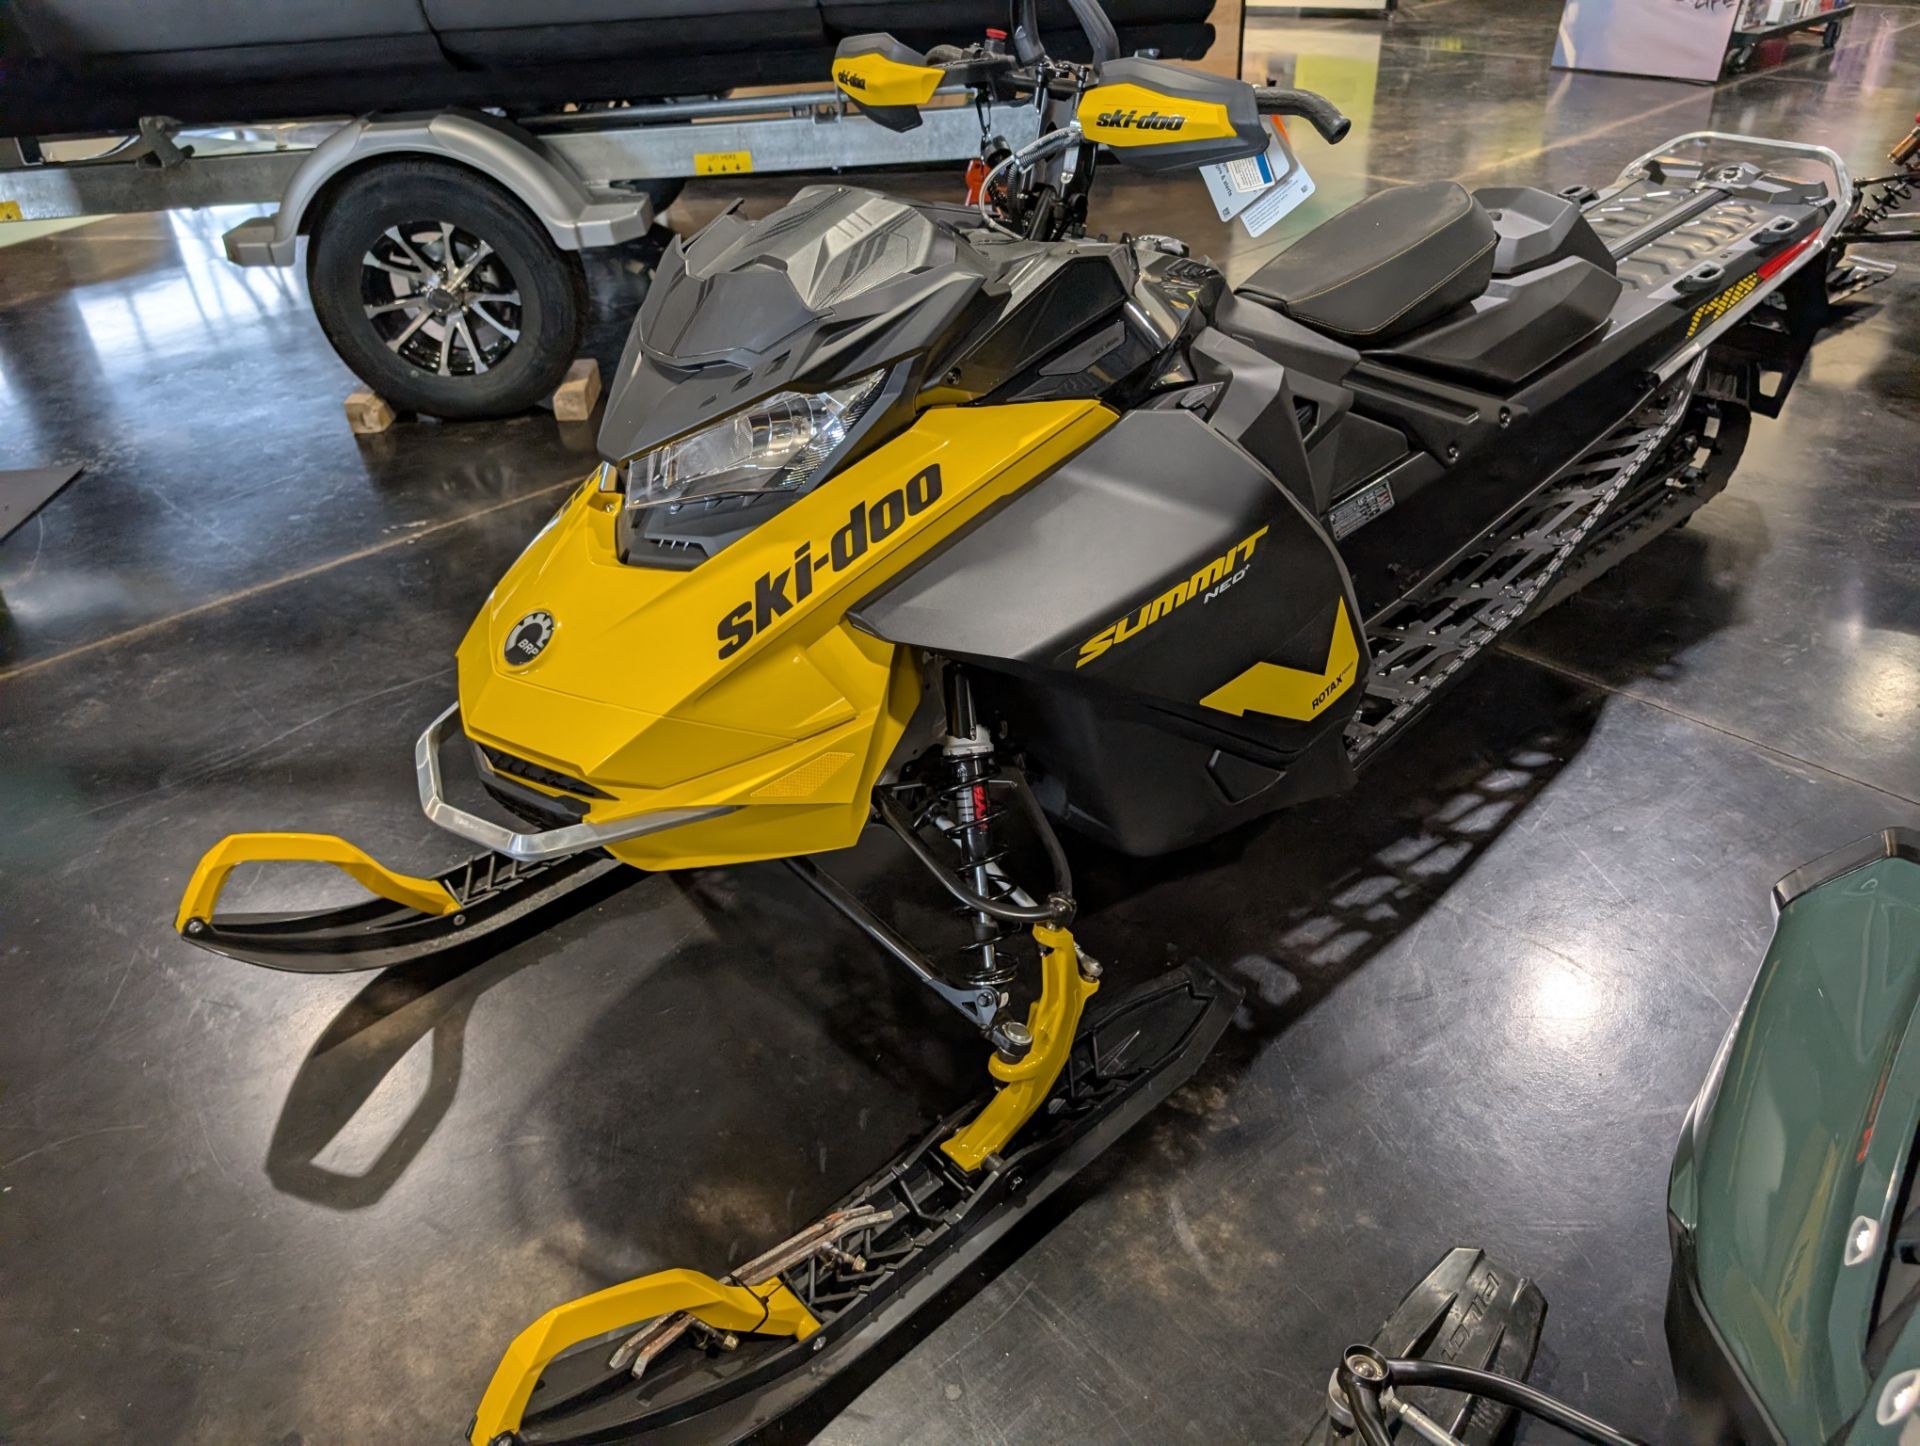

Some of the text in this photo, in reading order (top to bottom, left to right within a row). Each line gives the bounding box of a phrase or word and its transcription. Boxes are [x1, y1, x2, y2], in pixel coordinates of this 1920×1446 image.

[838, 70, 866, 90] ski-doo
[1096, 109, 1185, 131] ski-doo
[717, 463, 943, 660] ski-doo
[1076, 525, 1270, 669] SUMMIT
[517, 638, 539, 655] BRP
[1312, 674, 1343, 710] ROTAX
